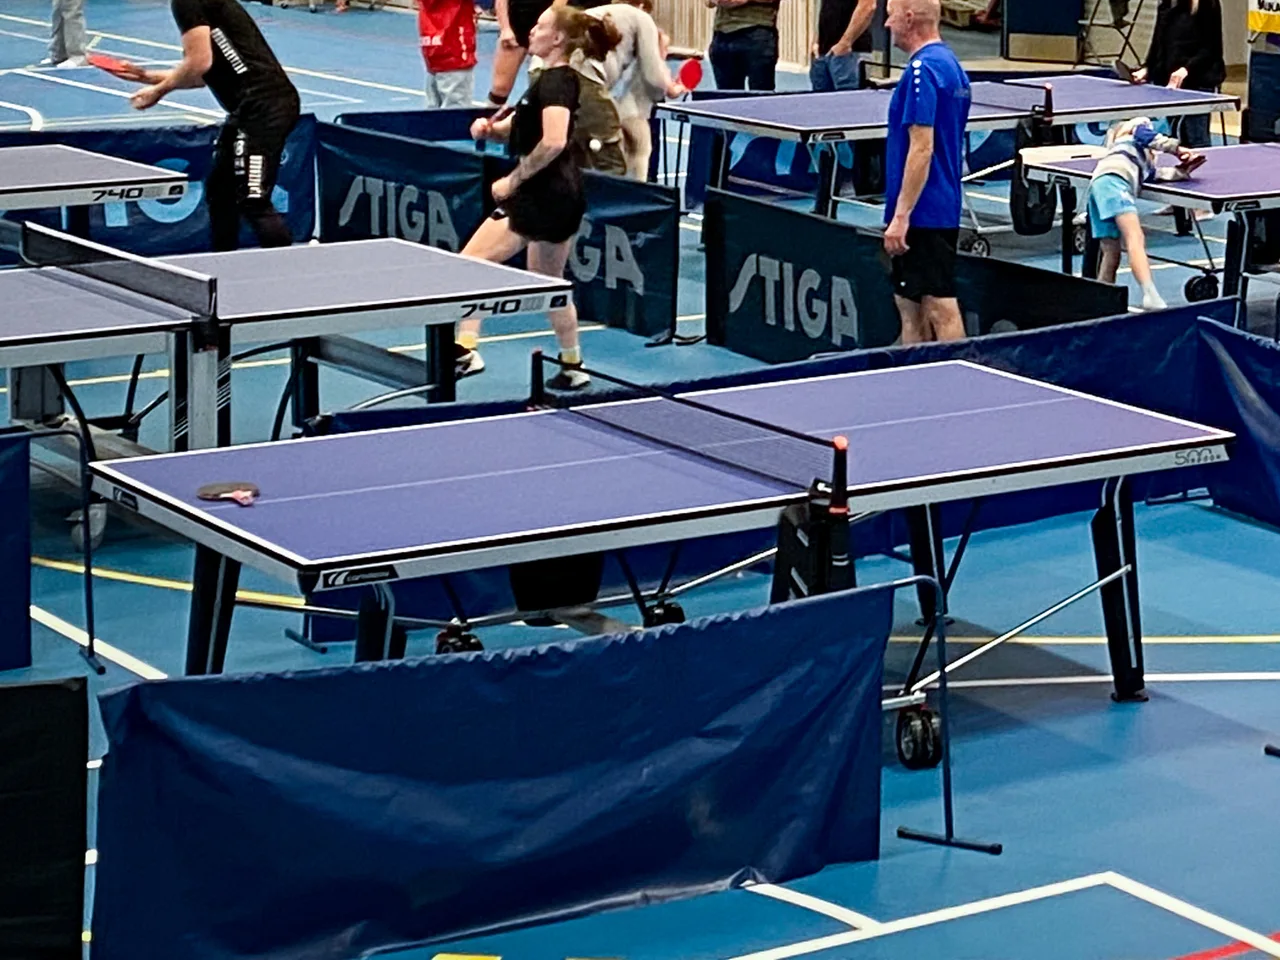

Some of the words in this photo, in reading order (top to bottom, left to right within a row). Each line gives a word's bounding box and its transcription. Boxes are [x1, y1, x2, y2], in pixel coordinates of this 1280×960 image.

[92, 187, 144, 202] 740
[338, 175, 460, 253] STIGA
[459, 297, 521, 318] 740
[728, 253, 860, 346] STIGA
